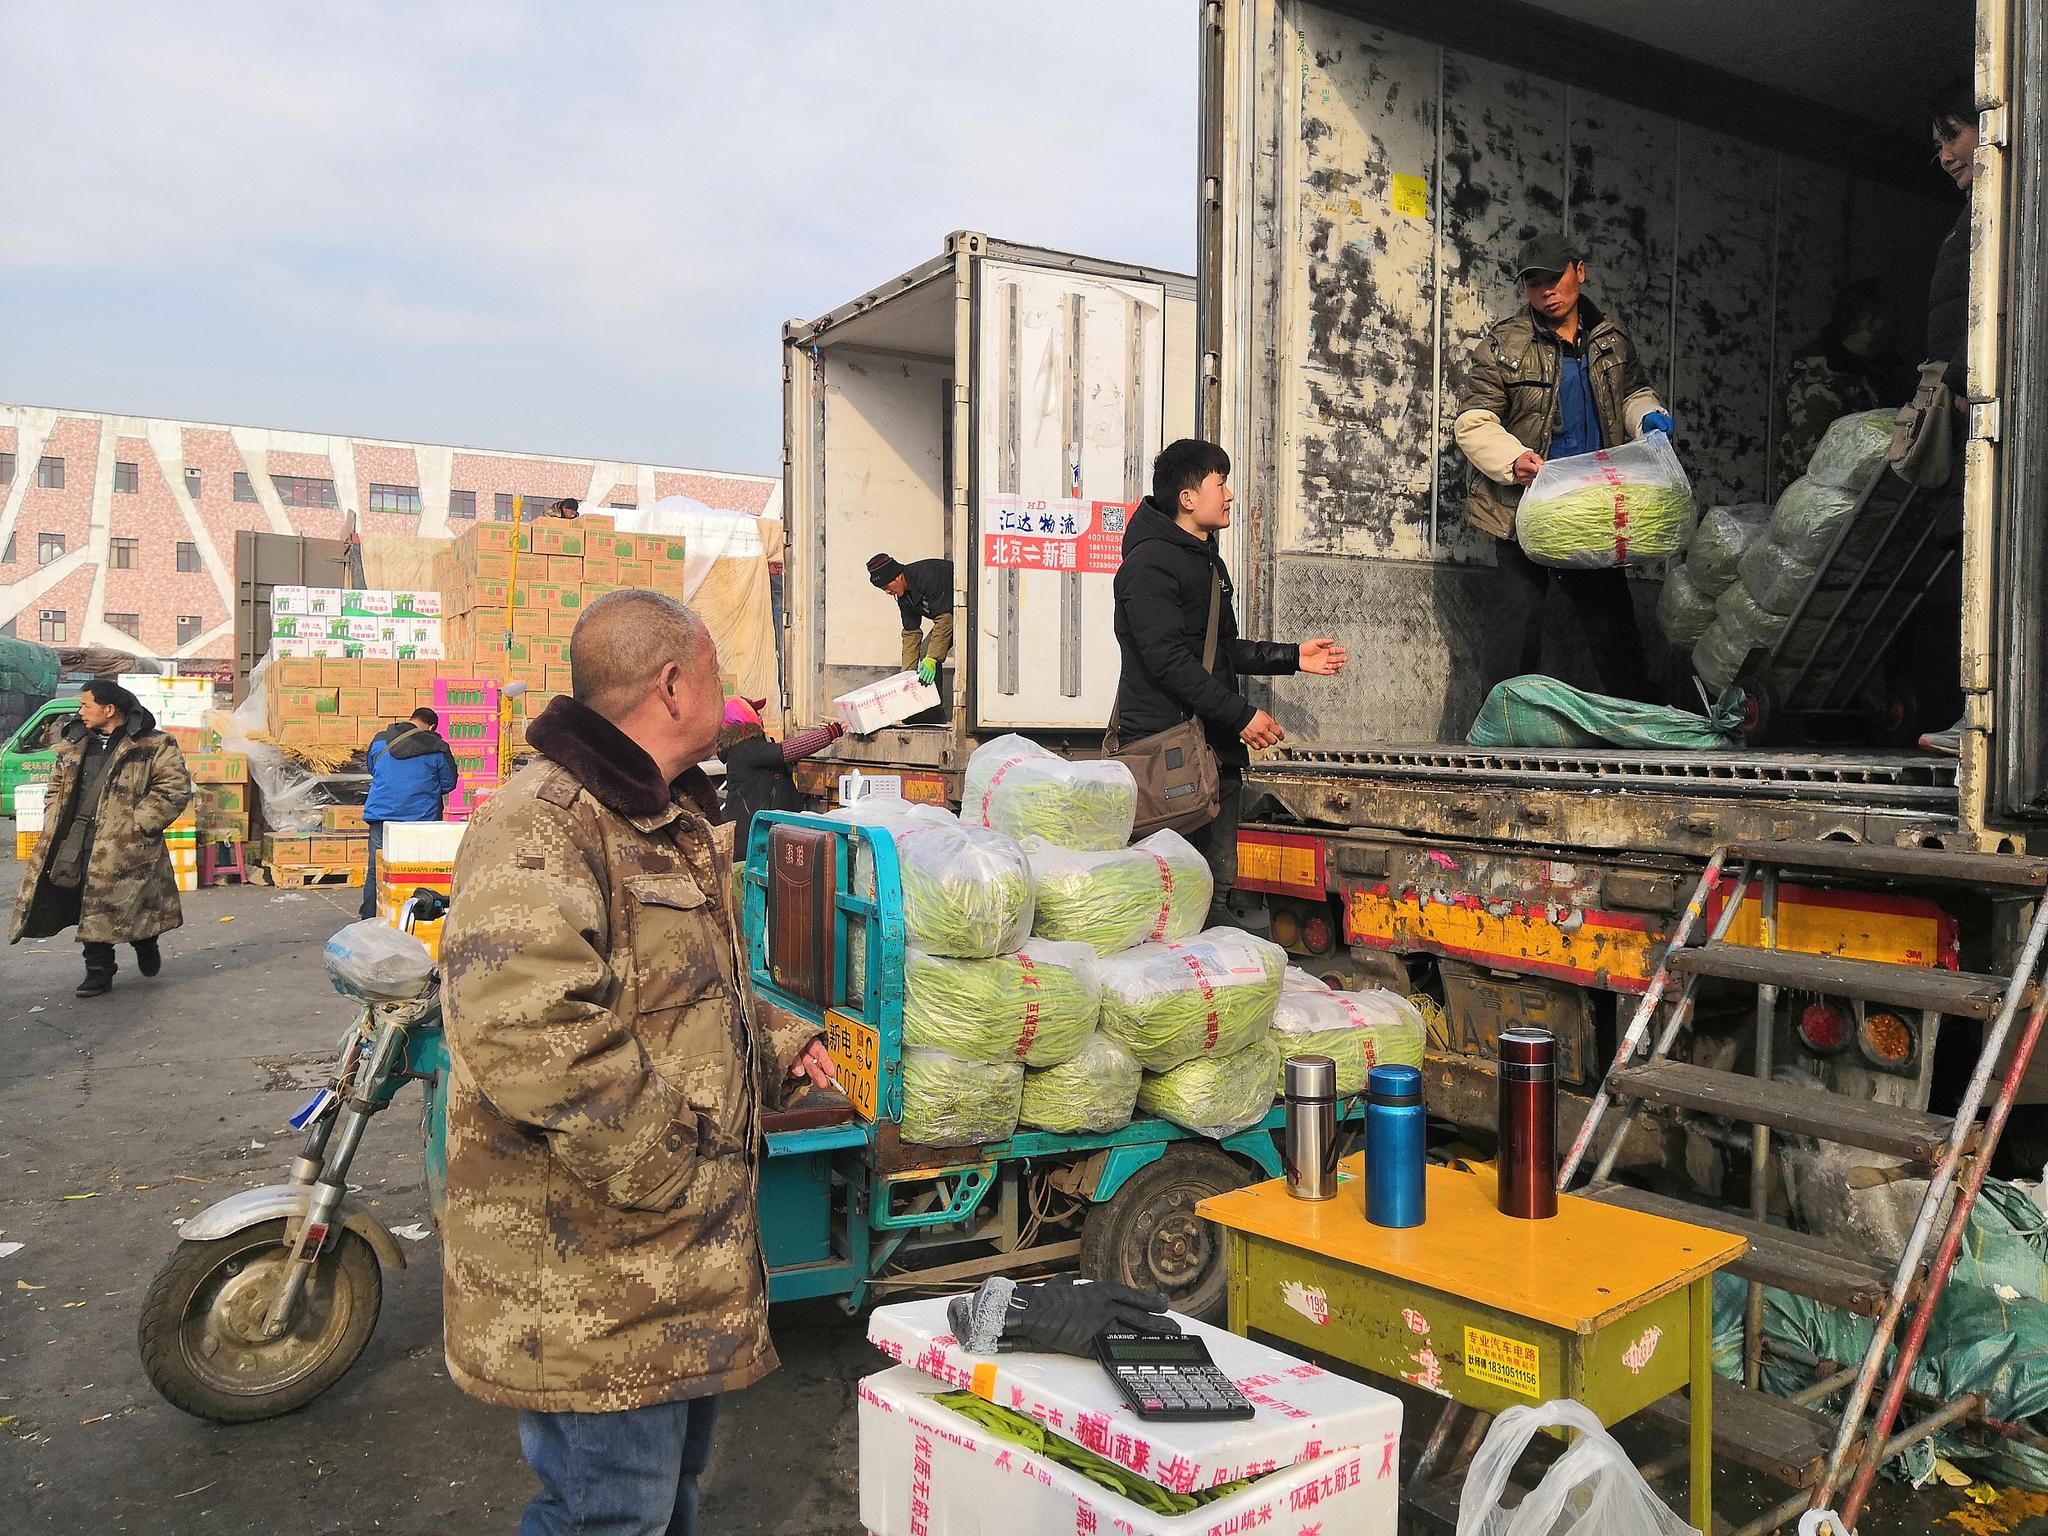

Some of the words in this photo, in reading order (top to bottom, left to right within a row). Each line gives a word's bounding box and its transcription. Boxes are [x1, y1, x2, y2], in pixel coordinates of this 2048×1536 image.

[999, 509, 1077, 535] 汇达物流
[992, 537, 1022, 564] 北京
[1042, 541, 1077, 568] 新疆
[1905, 949, 1922, 960] 3M
[829, 1020, 852, 1059] 新电
[865, 1035, 873, 1071] C
[1468, 1331, 1536, 1362] 专业汽车电路
[1488, 1360, 1537, 1385] 18310511156
[912, 1433, 933, 1536] 优质无筋豆
